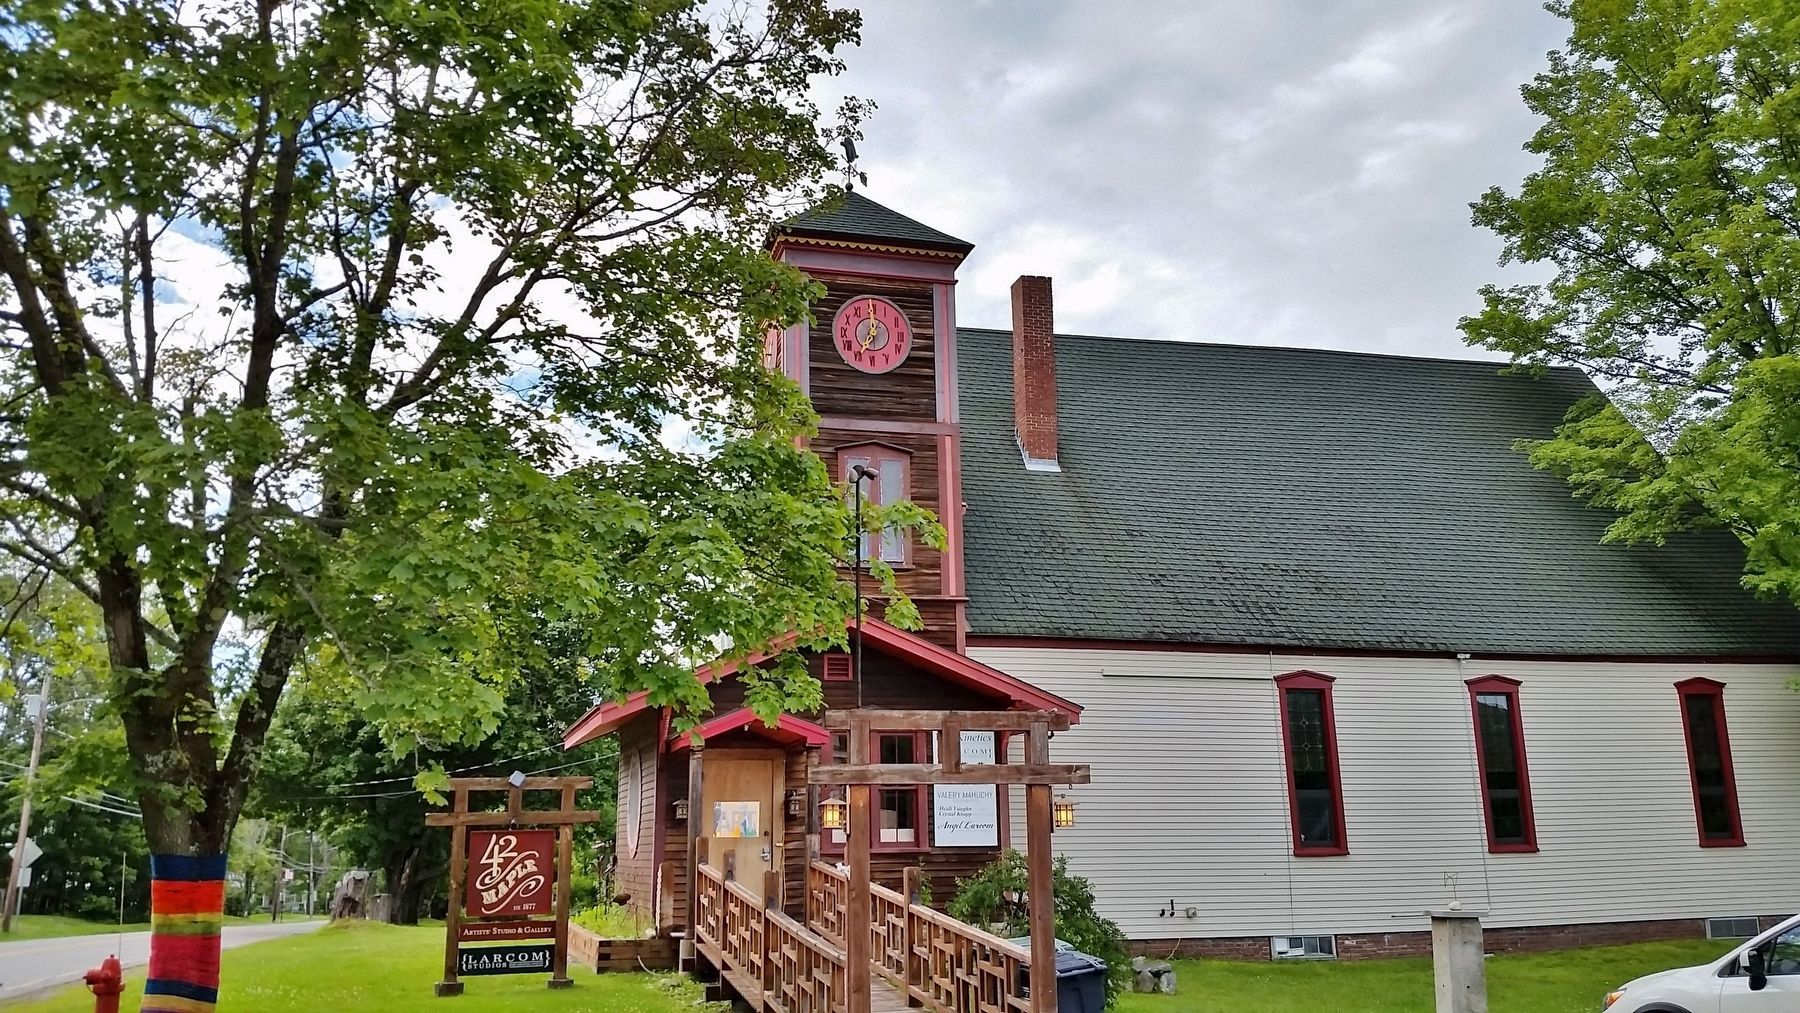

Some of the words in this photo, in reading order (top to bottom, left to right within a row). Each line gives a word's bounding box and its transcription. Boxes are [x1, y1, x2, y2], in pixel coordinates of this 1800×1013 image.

[854, 306, 861, 318] XI
[845, 313, 850, 325] X
[894, 317, 899, 328] II
[841, 326, 847, 338] IX
[938, 791, 960, 799] VALERY
[480, 833, 518, 877] 42
[481, 859, 538, 905] MAPLE
[492, 927, 516, 935] STUDIO
[524, 926, 552, 934] GALLERY
[467, 962, 507, 970] STUDIOS
